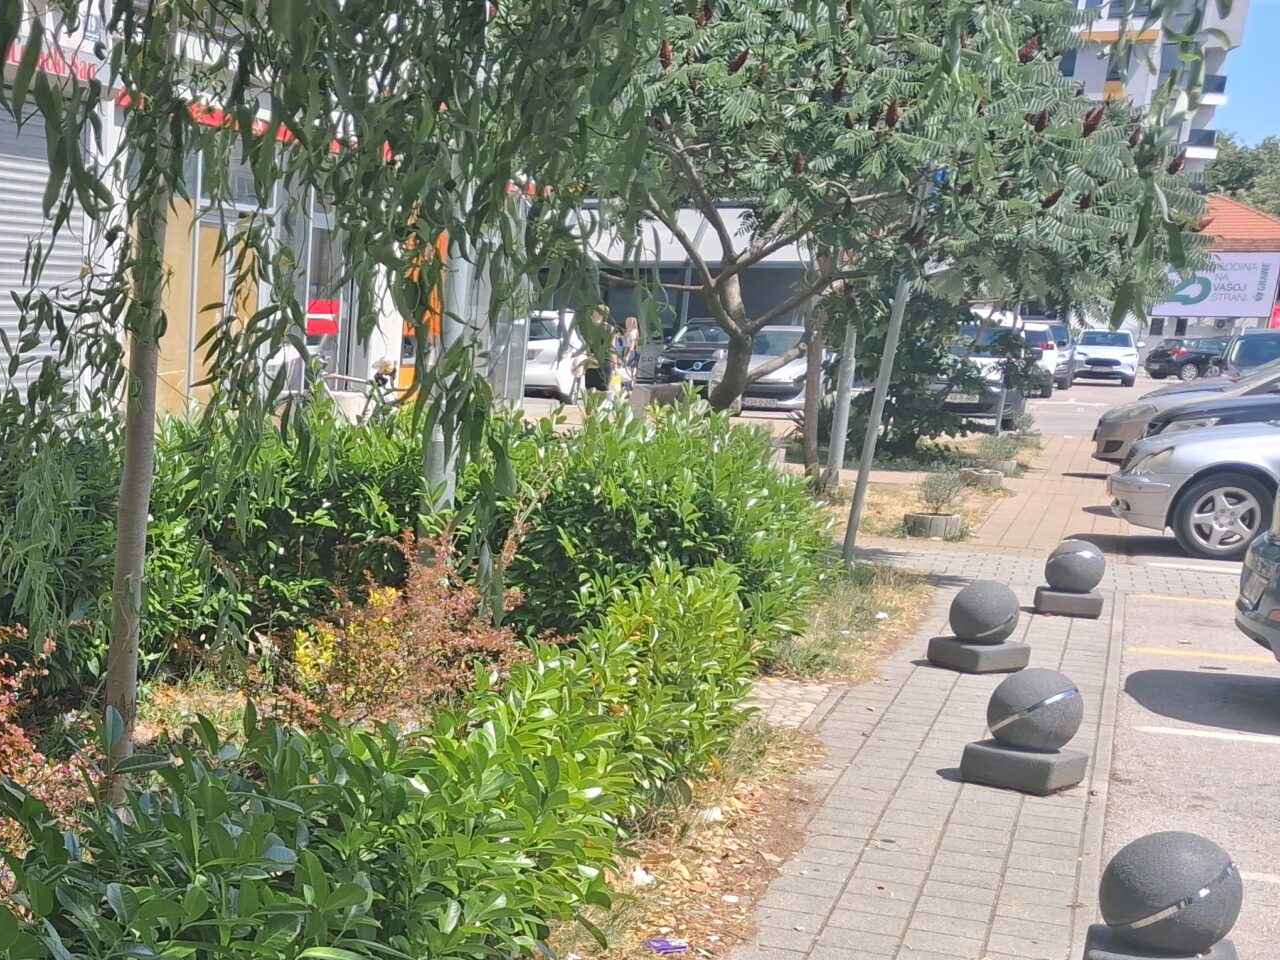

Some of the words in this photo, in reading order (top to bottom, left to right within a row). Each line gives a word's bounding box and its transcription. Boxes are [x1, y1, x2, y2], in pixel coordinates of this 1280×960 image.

[1214, 273, 1229, 281] NA
[1257, 262, 1270, 291] GRAWE
[1214, 281, 1247, 291] VAŠOJ
[1211, 293, 1247, 301] STRANI
